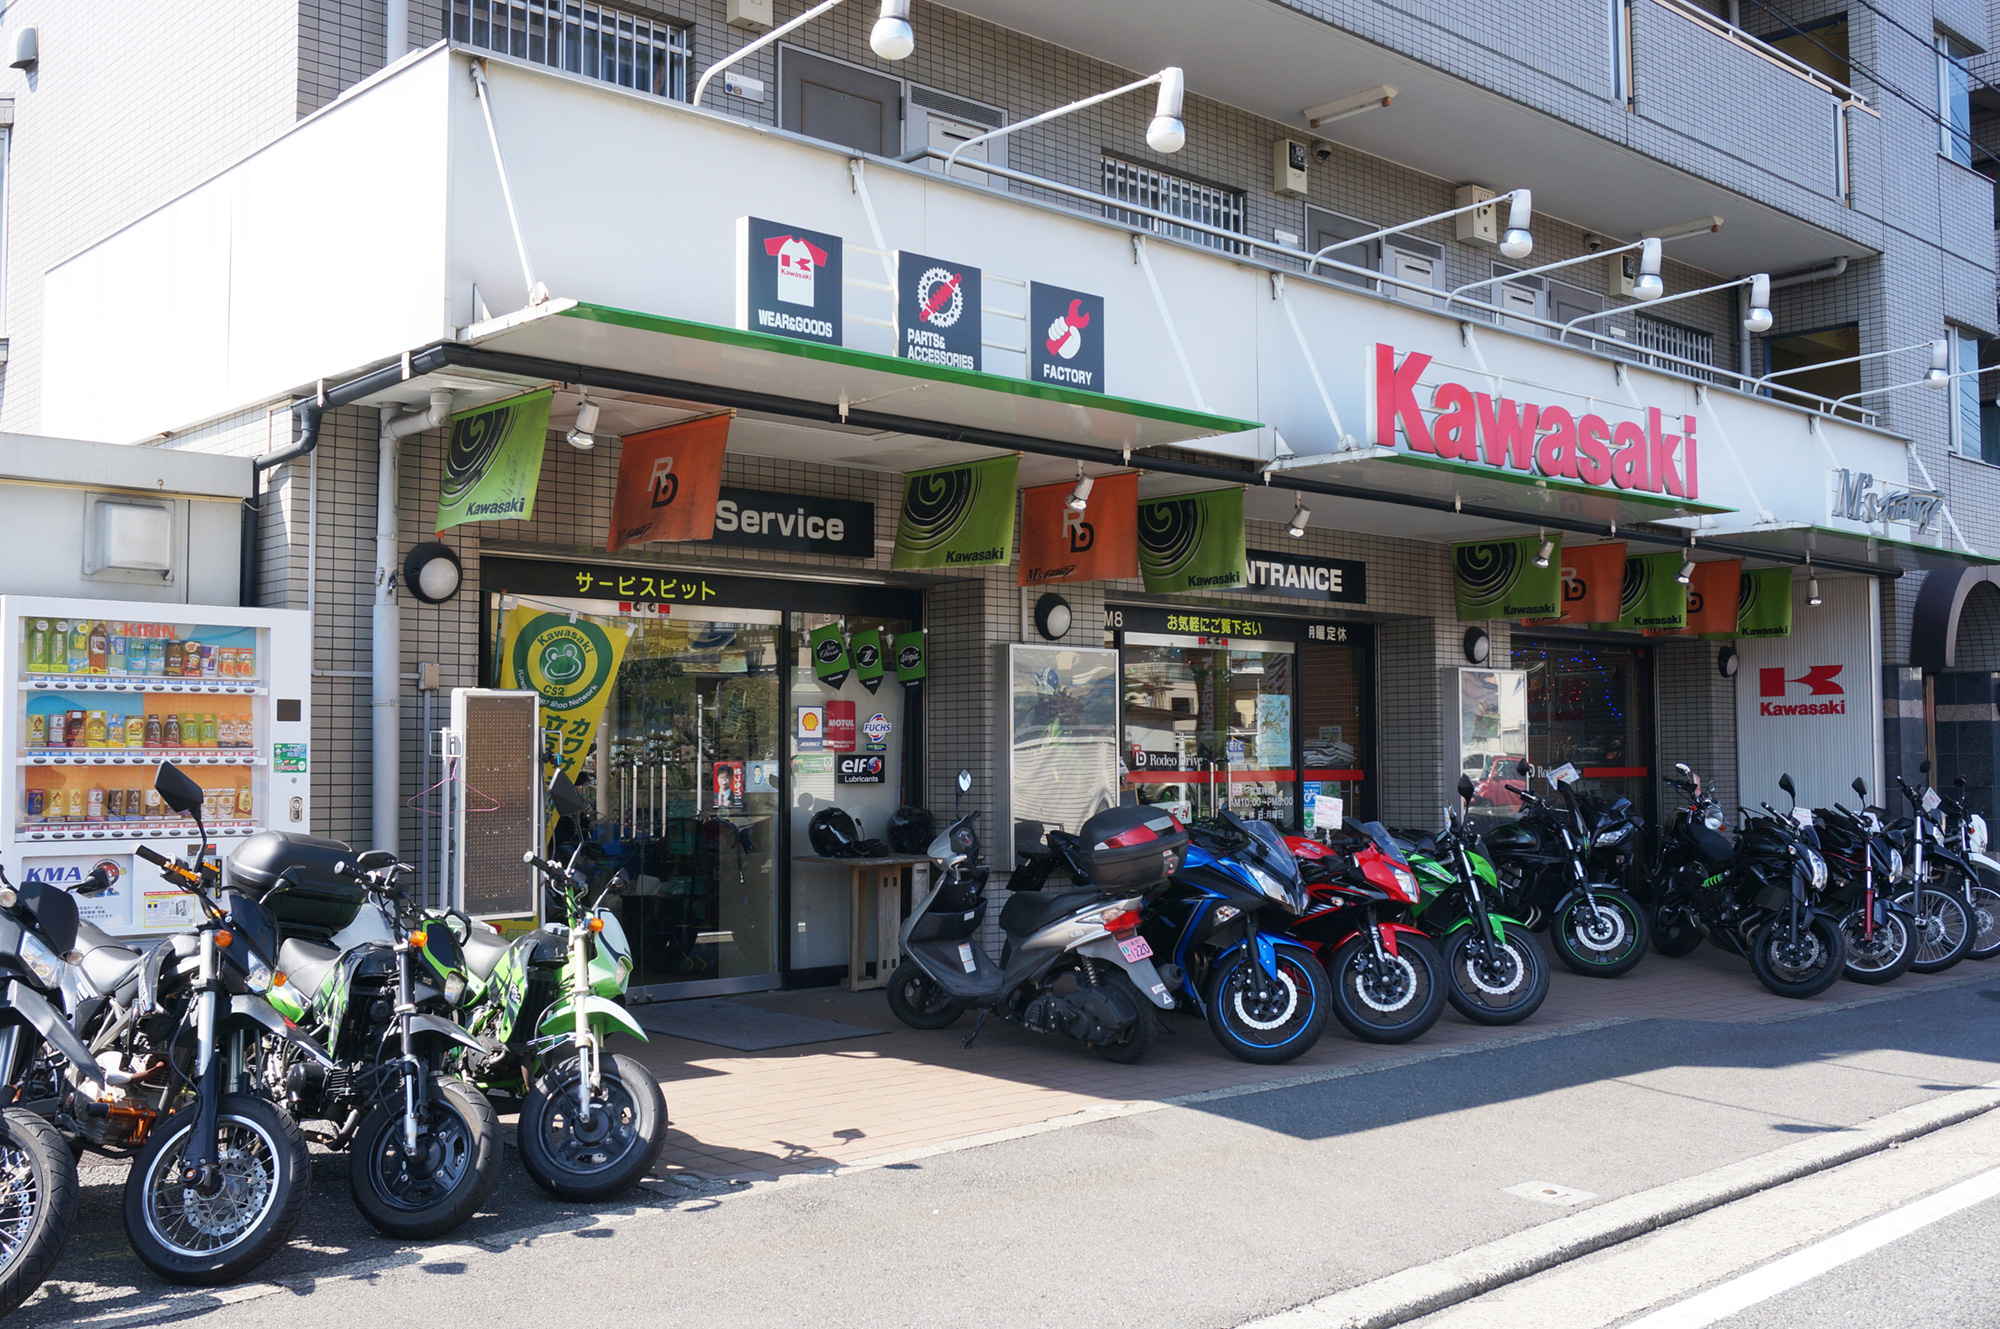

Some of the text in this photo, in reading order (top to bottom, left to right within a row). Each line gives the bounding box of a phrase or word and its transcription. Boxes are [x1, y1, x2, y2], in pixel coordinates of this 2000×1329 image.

[780, 267, 812, 281] Kawasaki
[757, 308, 833, 338] WEAR&GOODS
[907, 327, 945, 350] PARTS&
[907, 346, 974, 370] ACCESSORIES
[1043, 363, 1092, 386] FACTORY
[1372, 341, 1699, 500] Kawasaki
[465, 497, 526, 516] Kawasaki
[715, 499, 845, 542] Service
[945, 547, 1005, 563] Kawasaki
[1187, 571, 1241, 587] Kawasaki
[1245, 560, 1343, 592] NTRANCE
[575, 571, 717, 600] サービスピット
[1503, 603, 1555, 616] Kawasaki
[1167, 614, 1262, 636] お気軽にご覧下さい
[1633, 615, 1682, 626] Kawasaki
[123, 622, 176, 638] KIRIN
[1308, 625, 1347, 642] 月曜定休
[1742, 624, 1788, 637] Kawasaki
[536, 629, 595, 654] Kawasaki
[542, 684, 565, 696] CS2
[550, 700, 568, 709] Shop
[568, 684, 598, 707] Network
[1759, 699, 1846, 716] Kawasaki
[828, 719, 855, 727] MOTUL
[864, 723, 891, 732] FUCHS
[841, 758, 867, 773] elf
[1149, 753, 1177, 767] Rodeo
[844, 775, 879, 783] Lubricants
[26, 866, 82, 883] KMA
